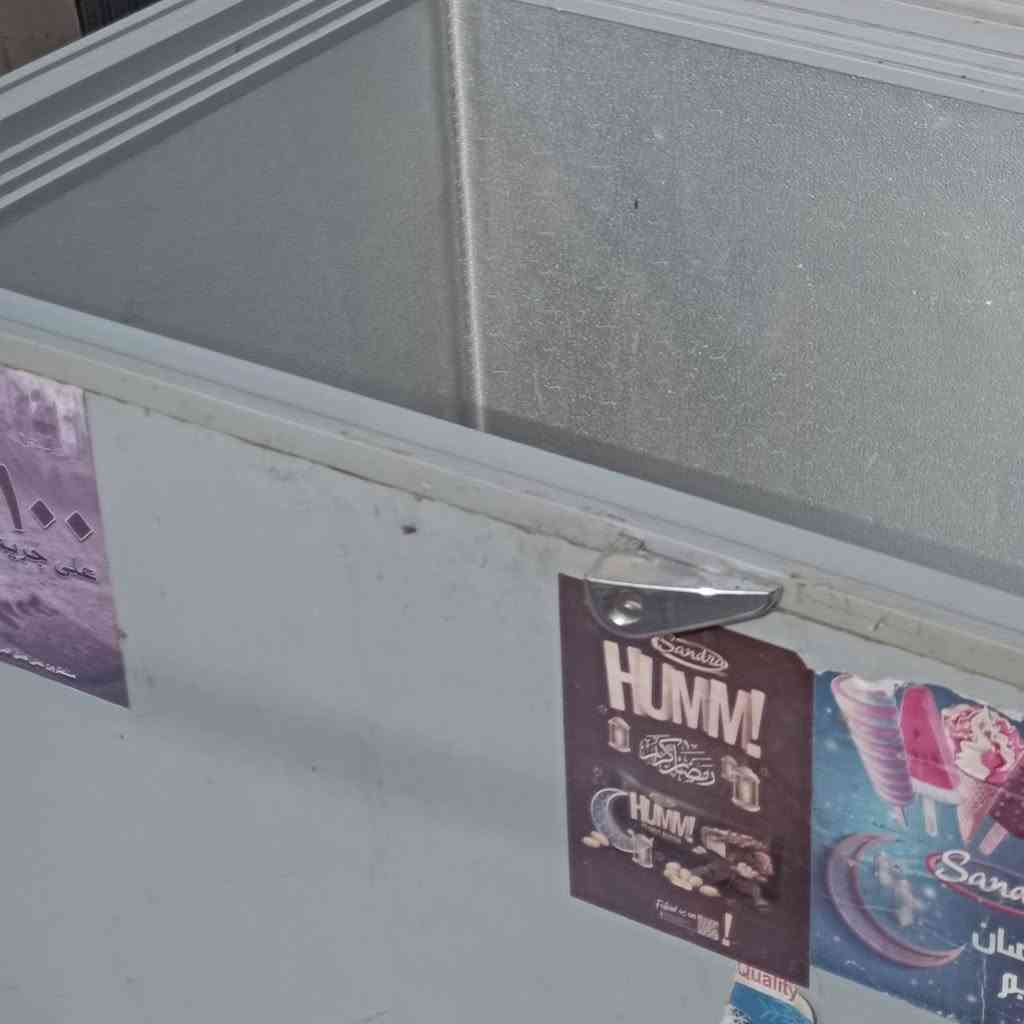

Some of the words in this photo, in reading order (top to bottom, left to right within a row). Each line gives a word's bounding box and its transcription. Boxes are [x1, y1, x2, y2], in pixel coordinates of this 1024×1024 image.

[657, 632, 727, 668] Sandra
[604, 640, 766, 759] HUMM!
[630, 792, 696, 843] HUMM!
